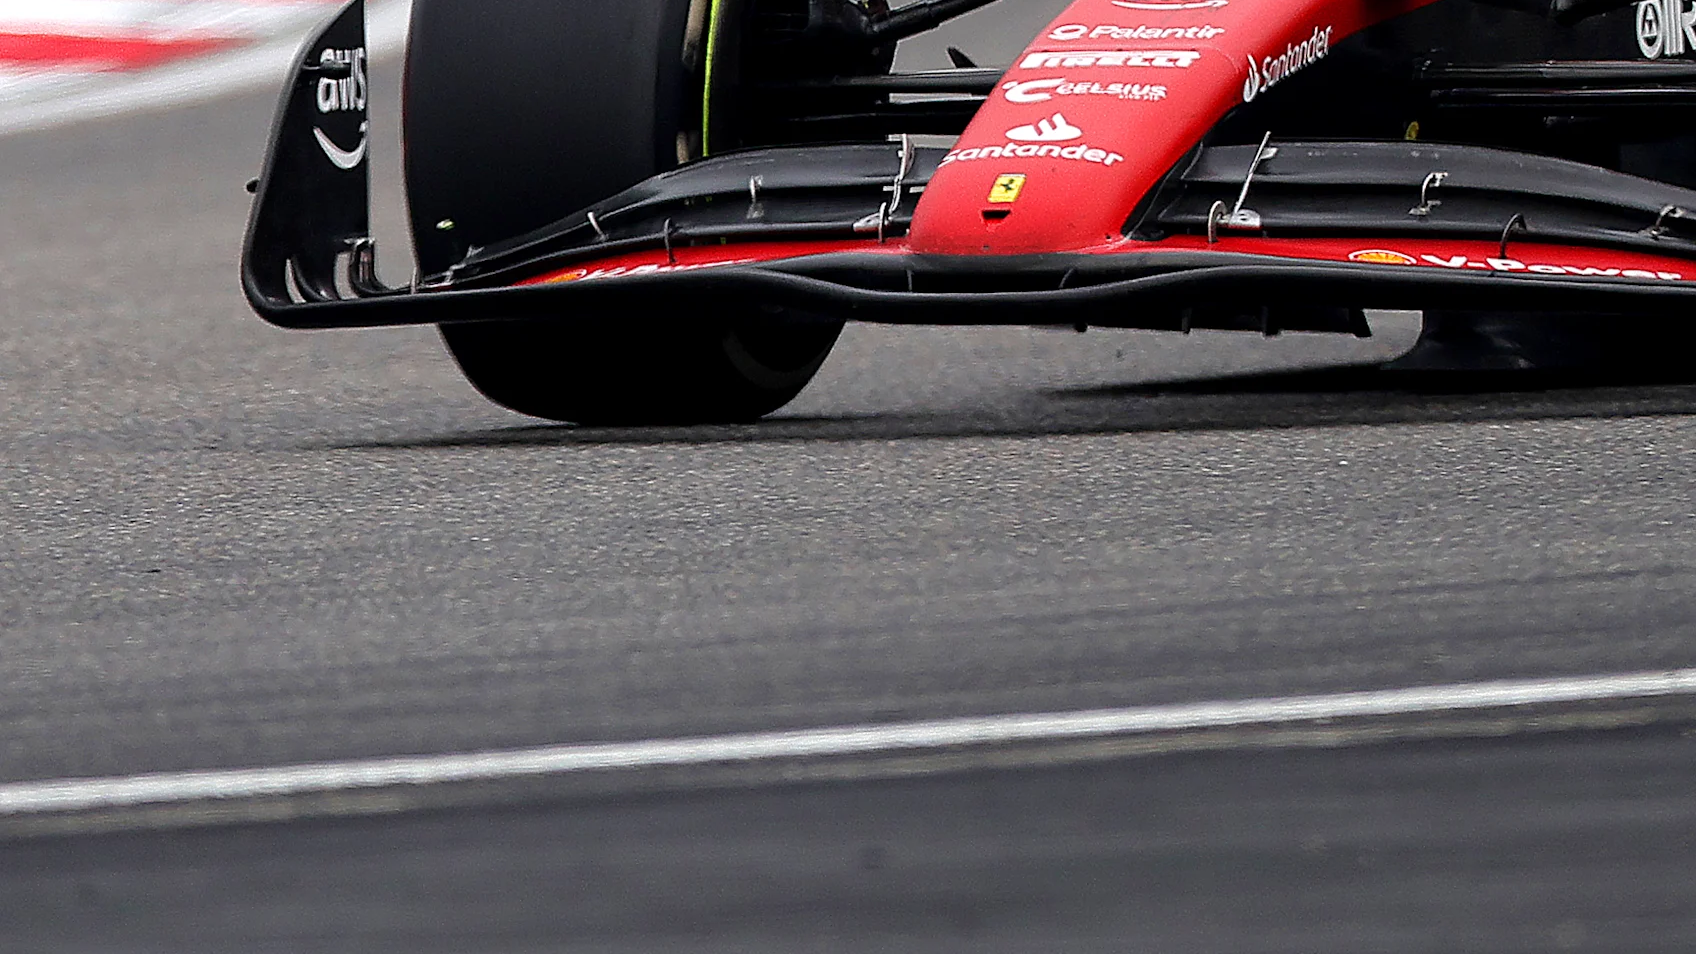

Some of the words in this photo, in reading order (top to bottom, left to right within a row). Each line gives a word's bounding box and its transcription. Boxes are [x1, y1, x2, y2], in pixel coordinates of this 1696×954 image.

[1088, 24, 1225, 40] Palantir
[1019, 49, 1201, 70] PIRELLI
[1260, 25, 1333, 93] Santander
[938, 142, 1124, 167] Santander
[1419, 253, 1683, 280] V-Power
